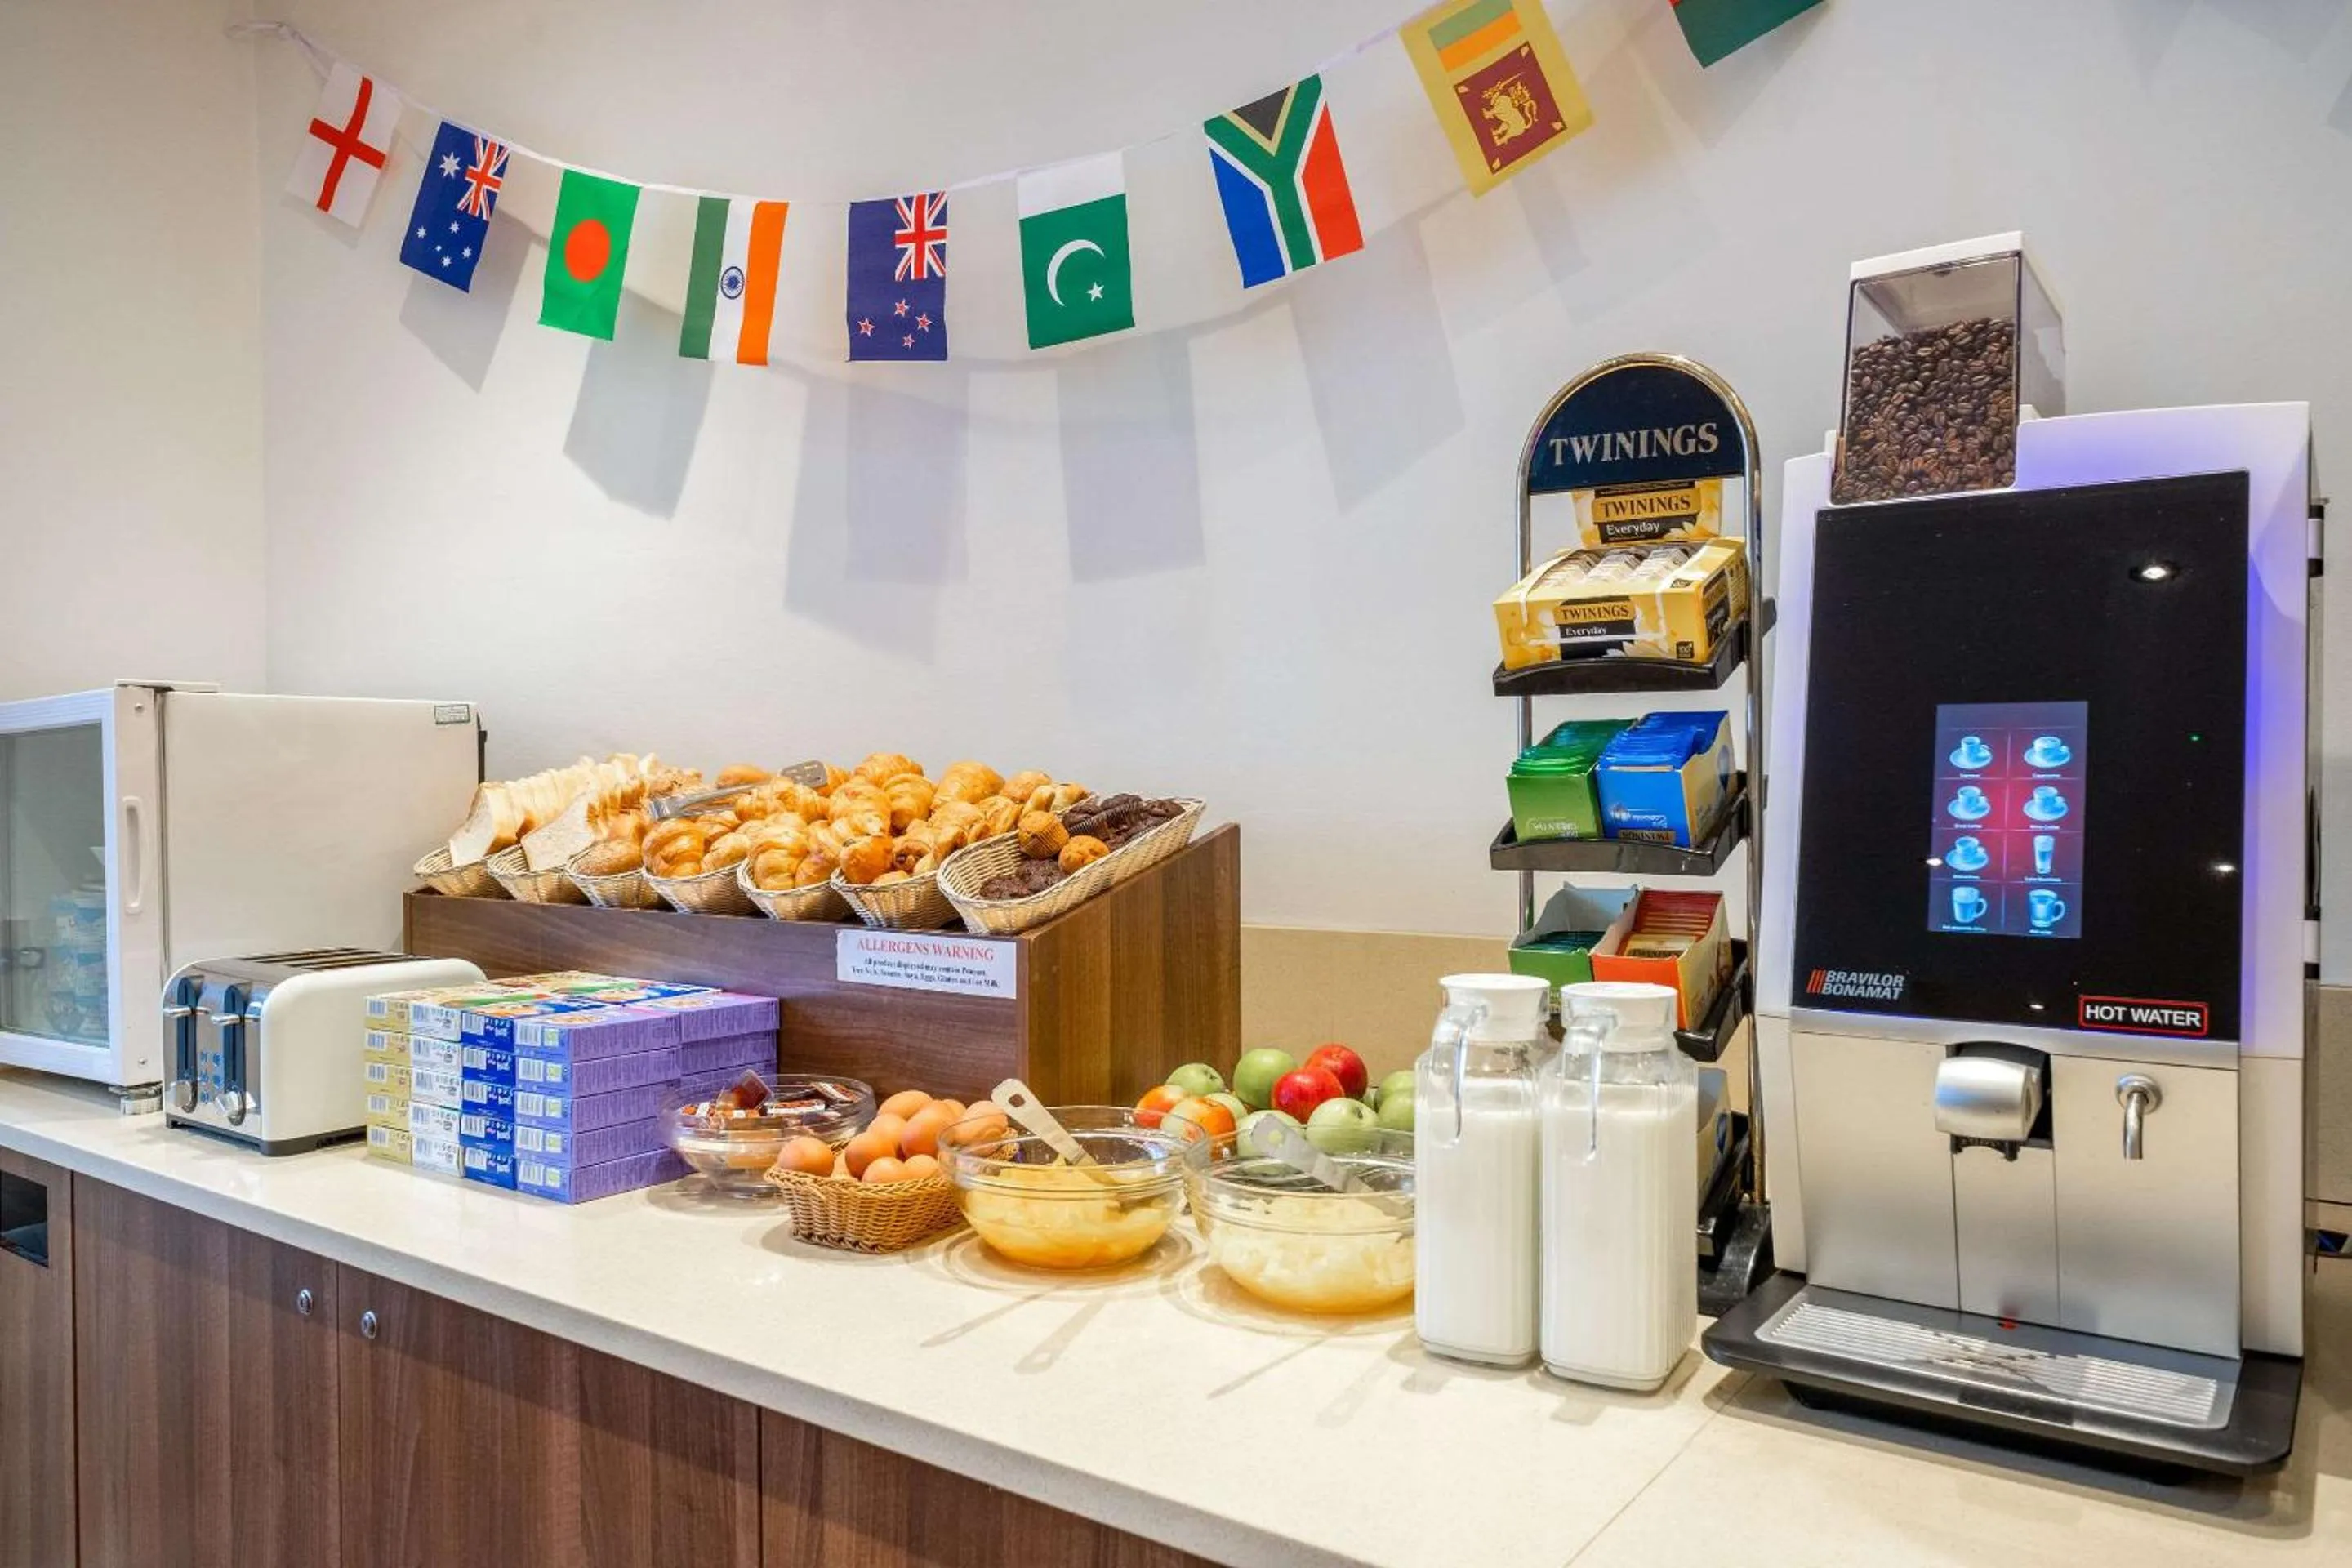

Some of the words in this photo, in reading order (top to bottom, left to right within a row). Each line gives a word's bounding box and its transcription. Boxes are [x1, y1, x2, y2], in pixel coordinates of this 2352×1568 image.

[1549, 422, 1719, 466] TWININGS
[1601, 494, 1691, 519] TWININGS
[1606, 521, 1660, 537] Everyday
[1561, 604, 1630, 621] TWININGS
[1566, 626, 1606, 636] Everyday
[858, 938, 929, 955] ALLERGENS
[932, 943, 995, 961] WARNING
[1825, 970, 1905, 987] BRAVILOR
[1821, 982, 1904, 1000] BONAMAT
[2085, 1004, 2126, 1022] HOT
[2132, 1008, 2202, 1027] WATER
